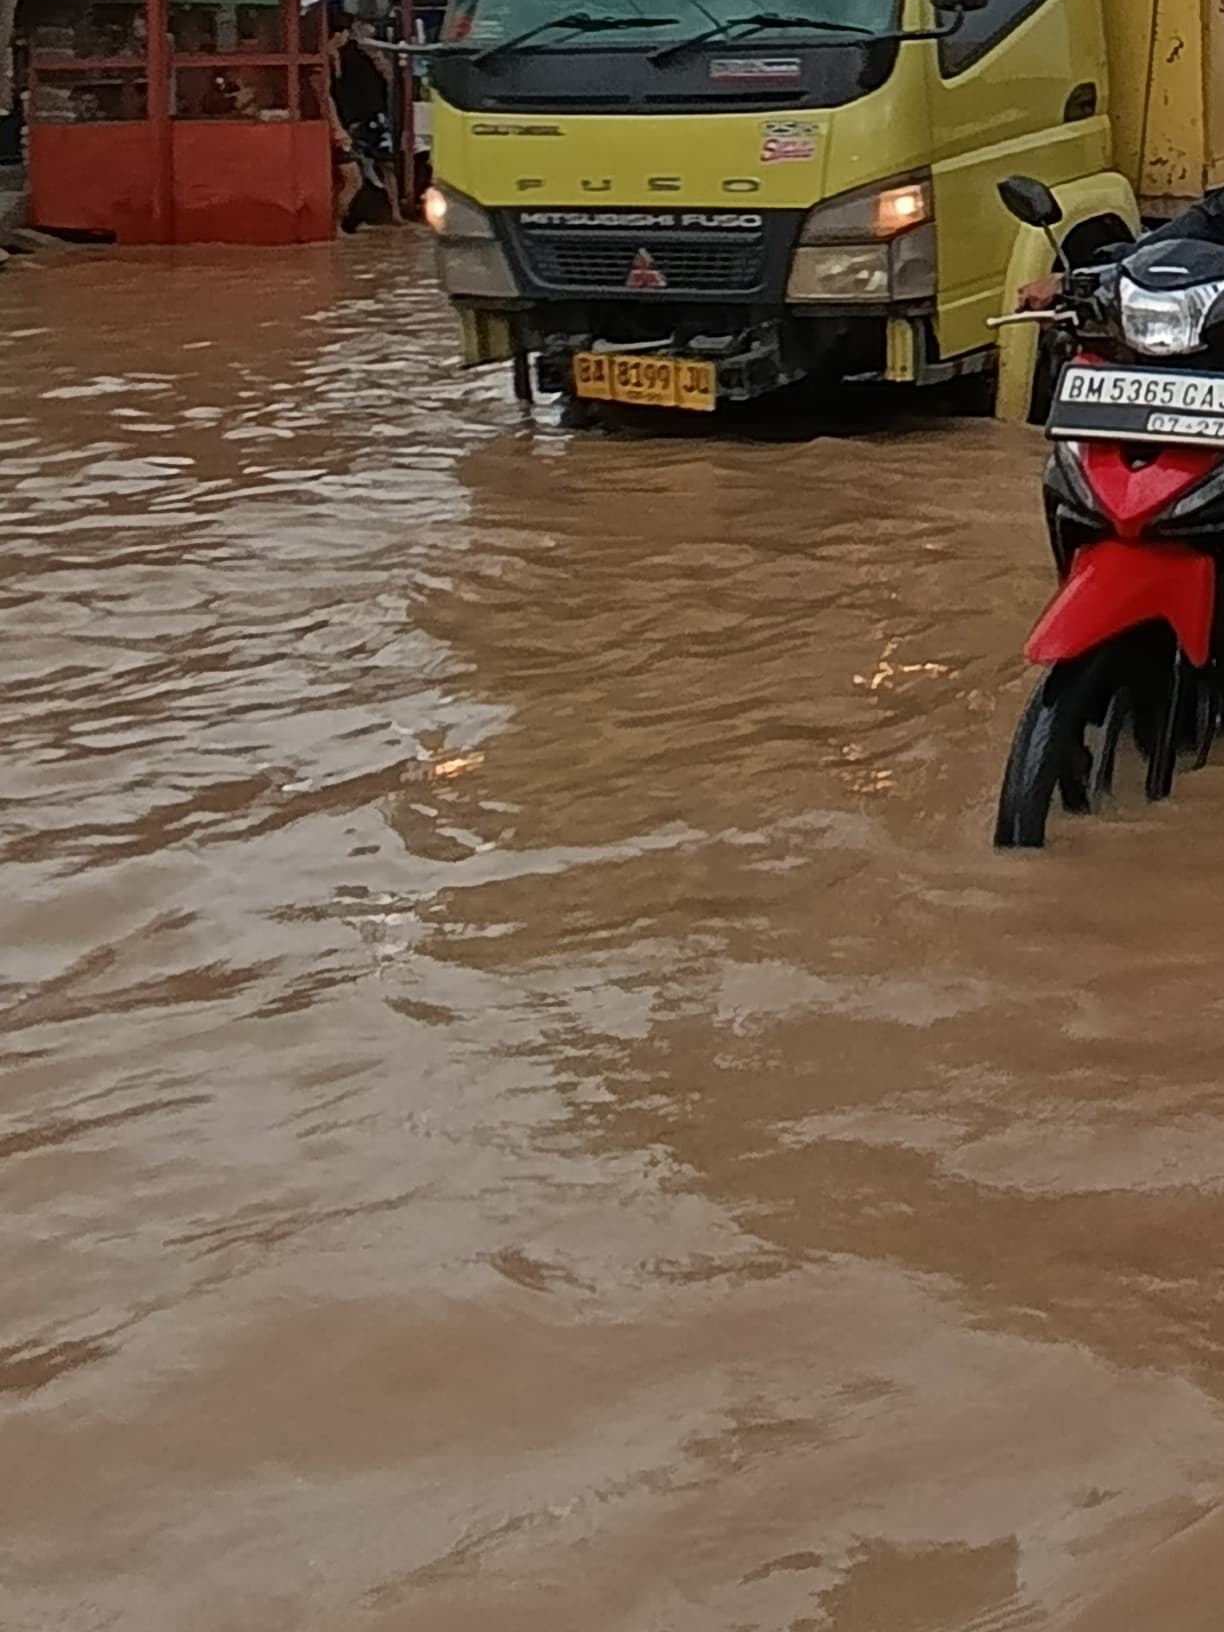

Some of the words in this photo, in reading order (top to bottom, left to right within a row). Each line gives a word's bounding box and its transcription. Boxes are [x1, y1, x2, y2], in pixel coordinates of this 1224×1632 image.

[520, 212, 675, 227] MITSUBISHI
[681, 213, 763, 228] FUSO
[617, 360, 671, 390] 8199
[1069, 375, 1105, 399] BM
[1110, 377, 1177, 405] 5365
